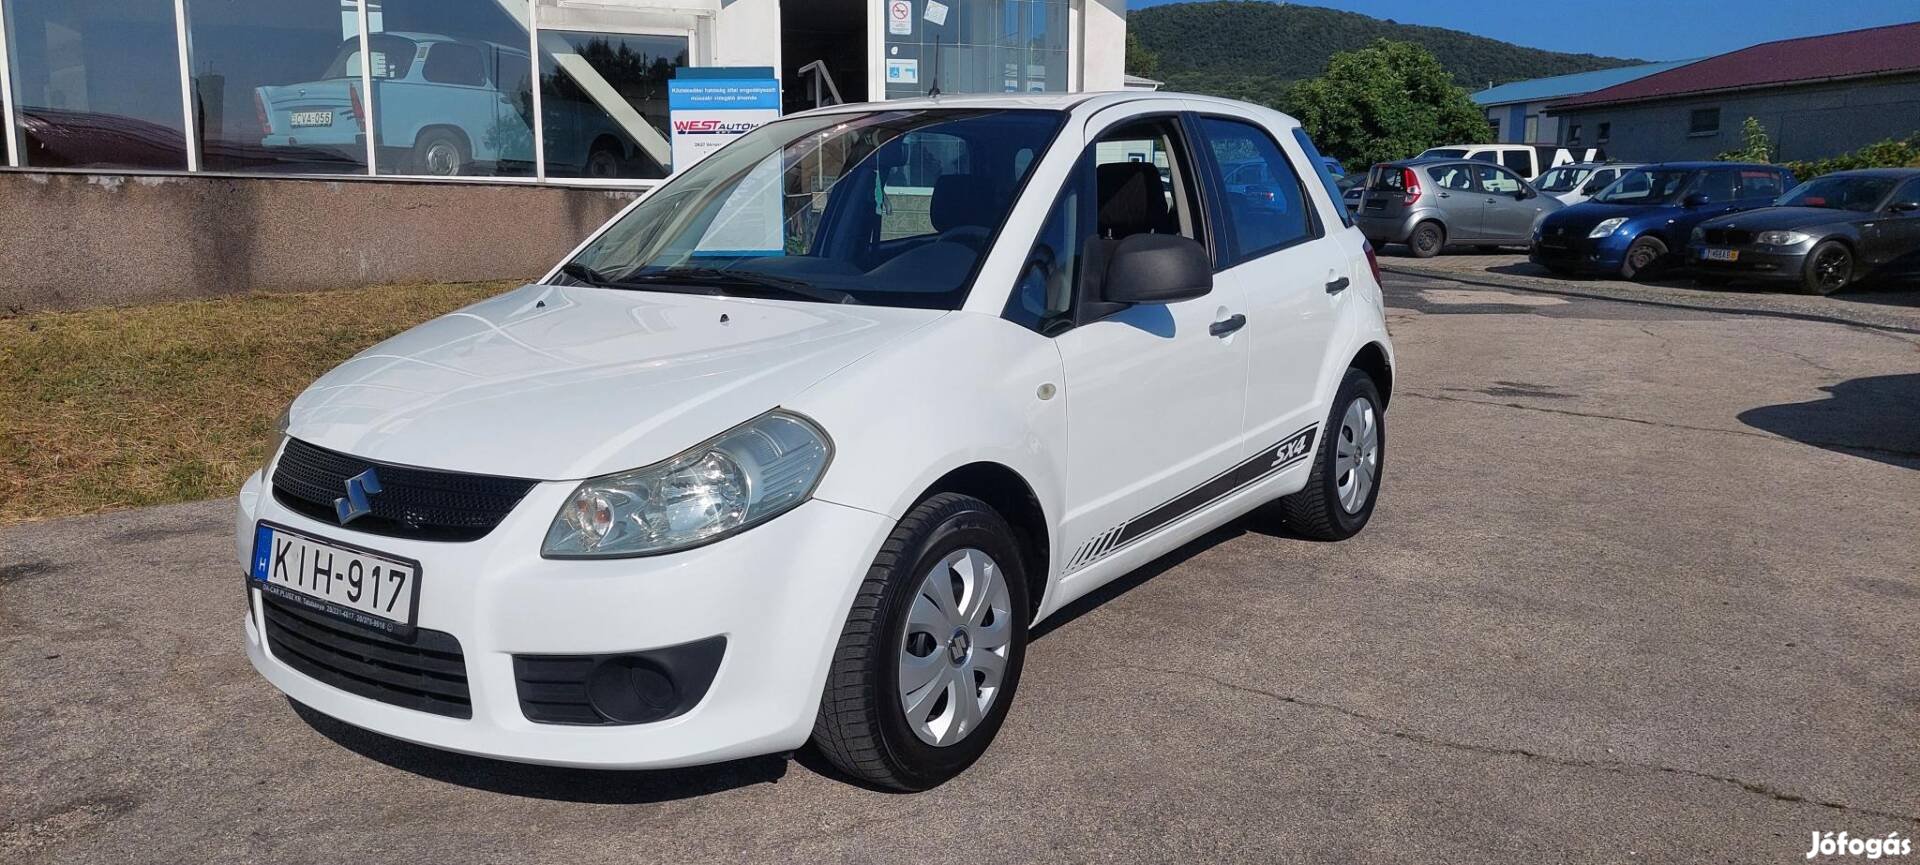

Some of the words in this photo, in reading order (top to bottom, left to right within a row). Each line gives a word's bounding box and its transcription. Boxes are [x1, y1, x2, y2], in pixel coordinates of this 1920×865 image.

[296, 112, 330, 124] CVA-056
[1270, 435, 1306, 467] SX4
[259, 558, 266, 572] H
[273, 537, 406, 613] KIH-917
